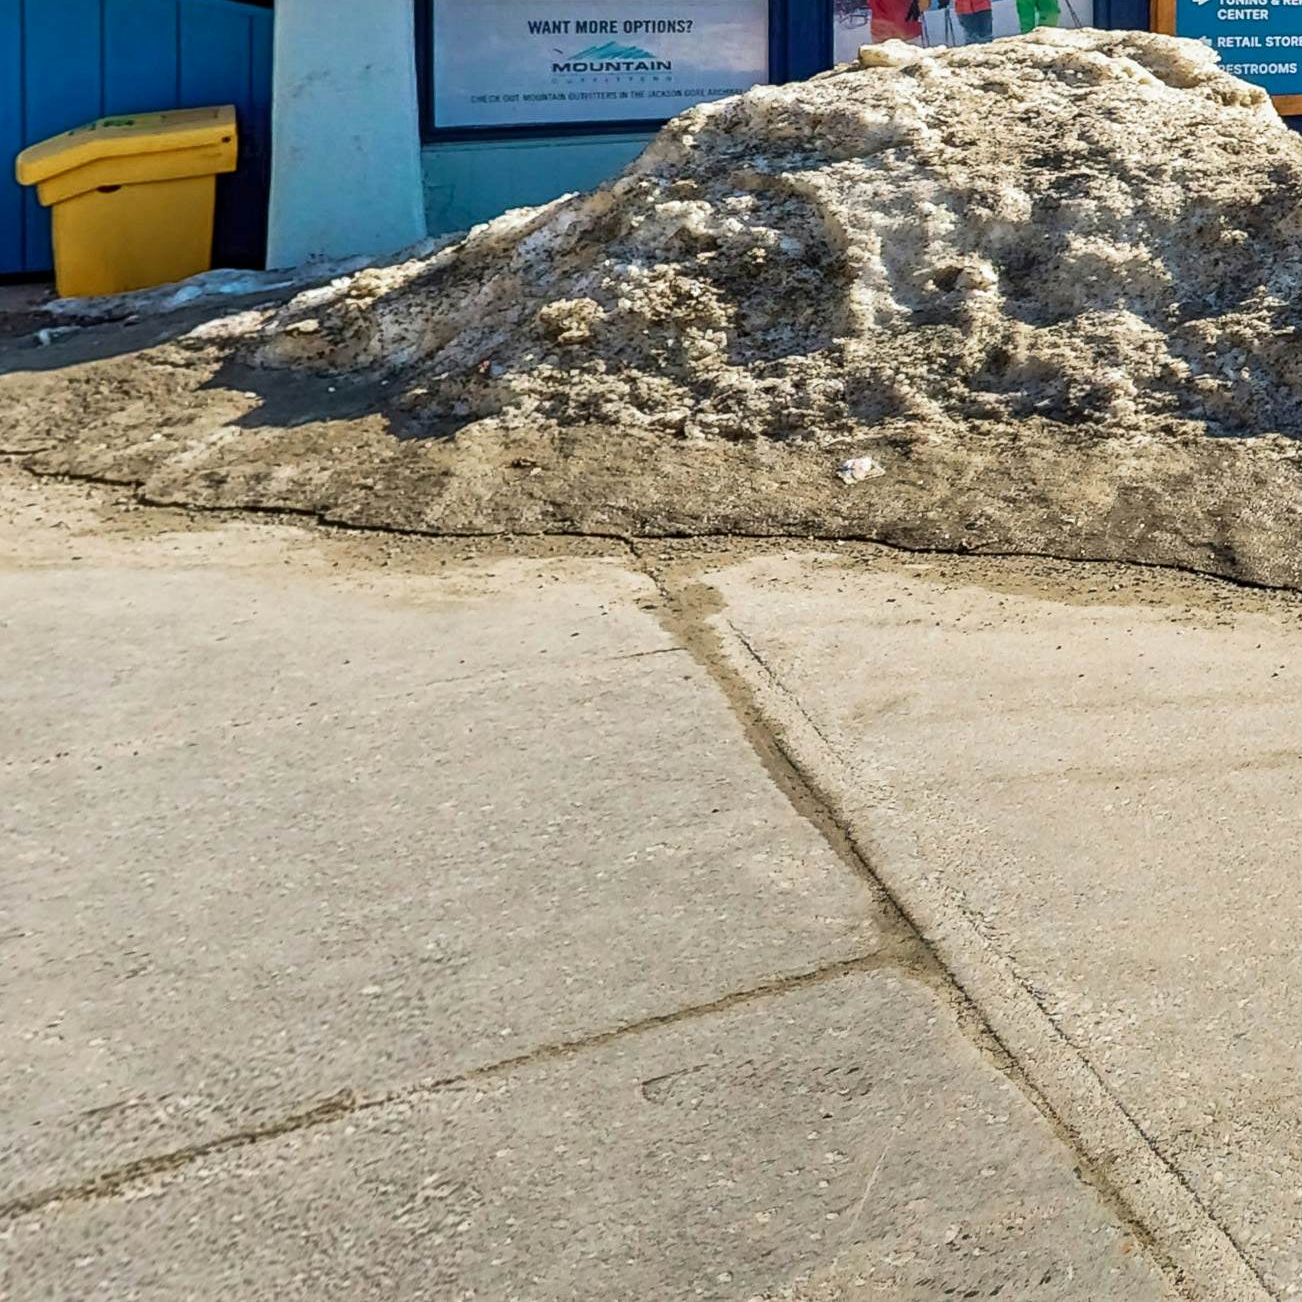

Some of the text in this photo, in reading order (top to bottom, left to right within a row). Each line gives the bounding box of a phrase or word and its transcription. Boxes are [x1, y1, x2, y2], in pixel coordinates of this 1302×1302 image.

[1217, 9, 1269, 20] CENTER
[527, 19, 693, 35] WANT MORE OPTIONS?
[1217, 36, 1262, 48] RETAIL
[552, 60, 672, 73] MOUNTAIN
